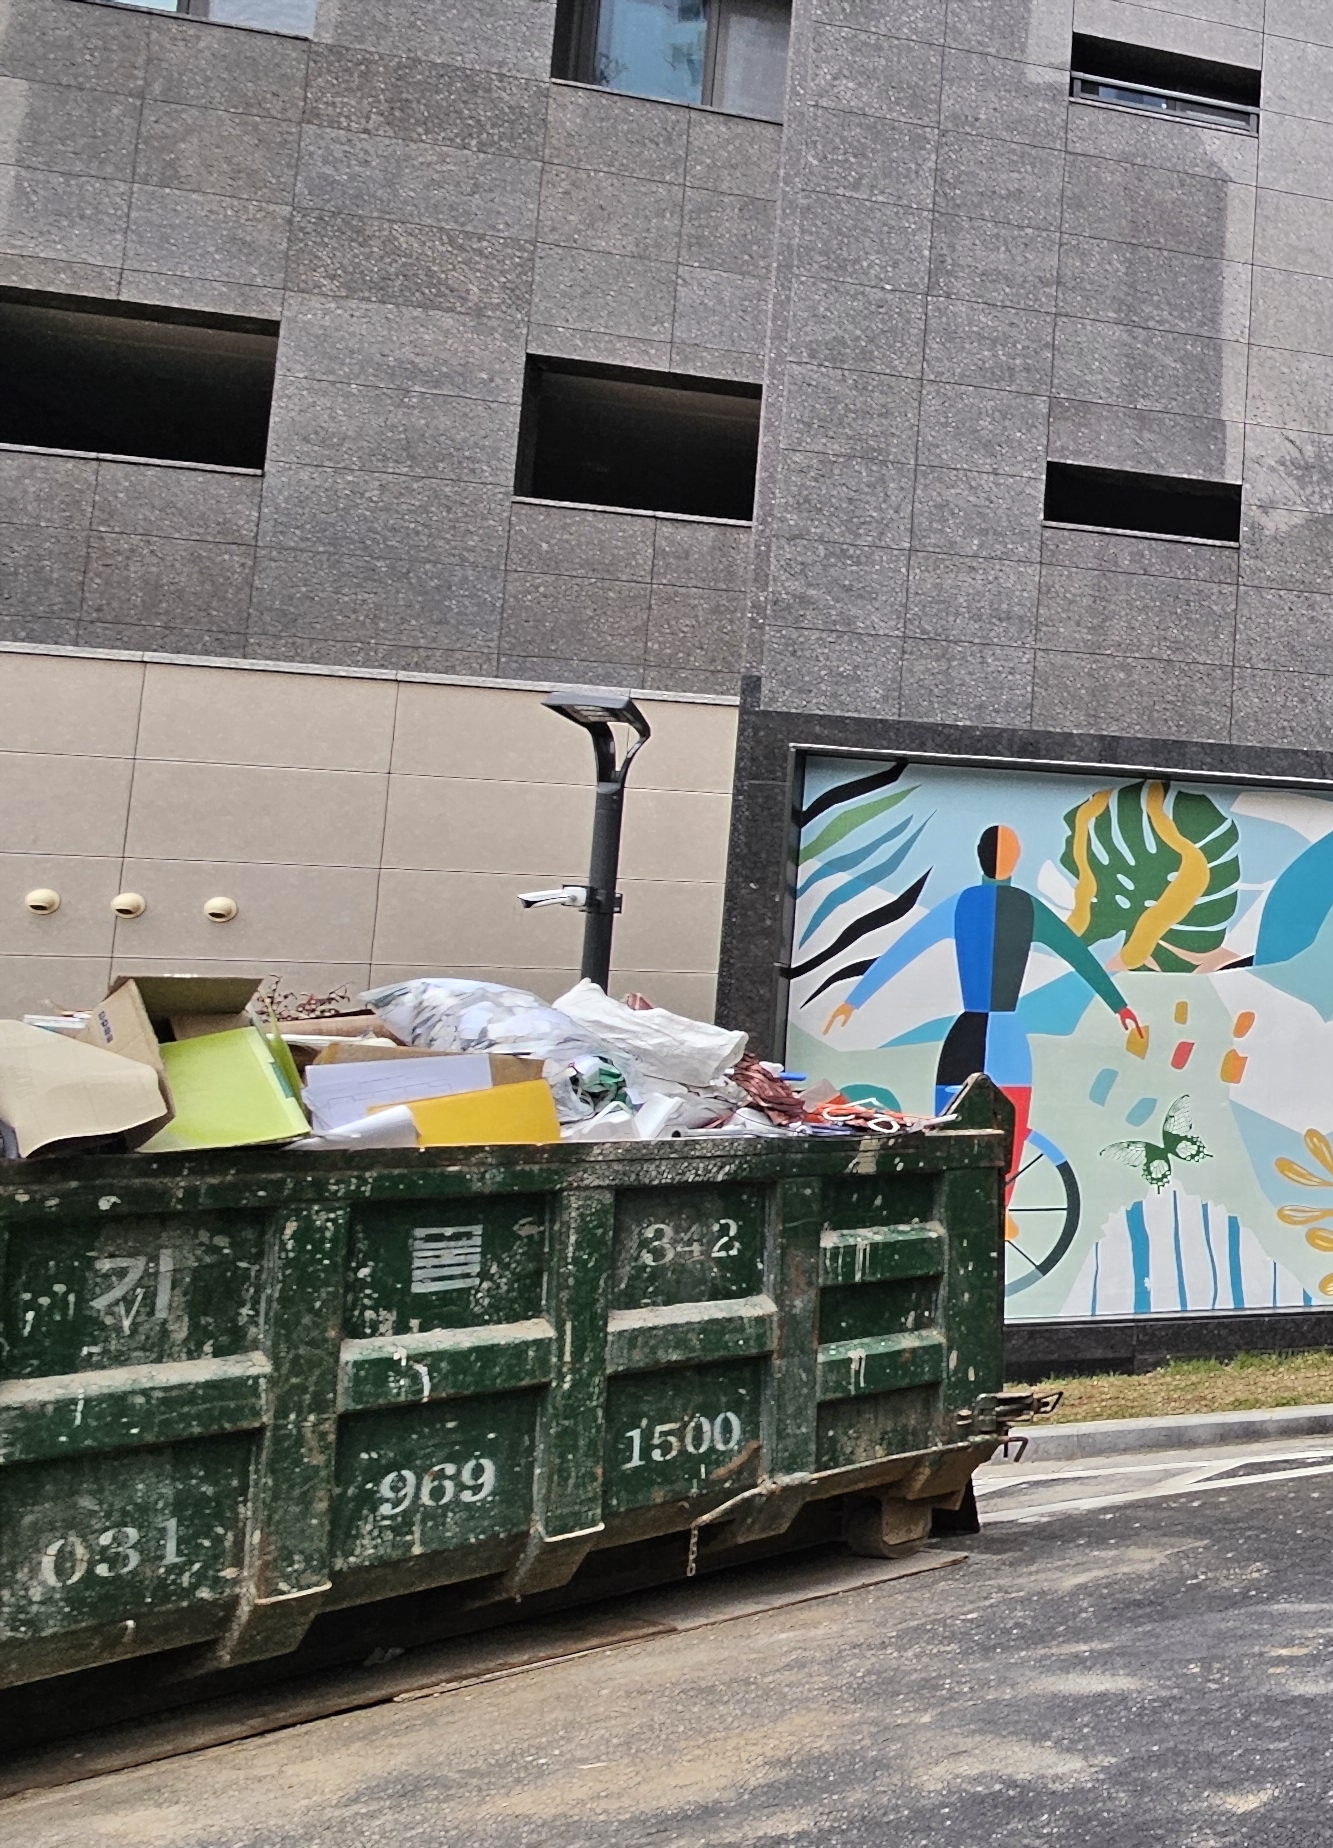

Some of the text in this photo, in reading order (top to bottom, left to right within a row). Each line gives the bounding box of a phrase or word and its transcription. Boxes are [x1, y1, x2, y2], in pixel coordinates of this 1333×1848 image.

[41, 1411, 742, 1587] 031 969 1500
